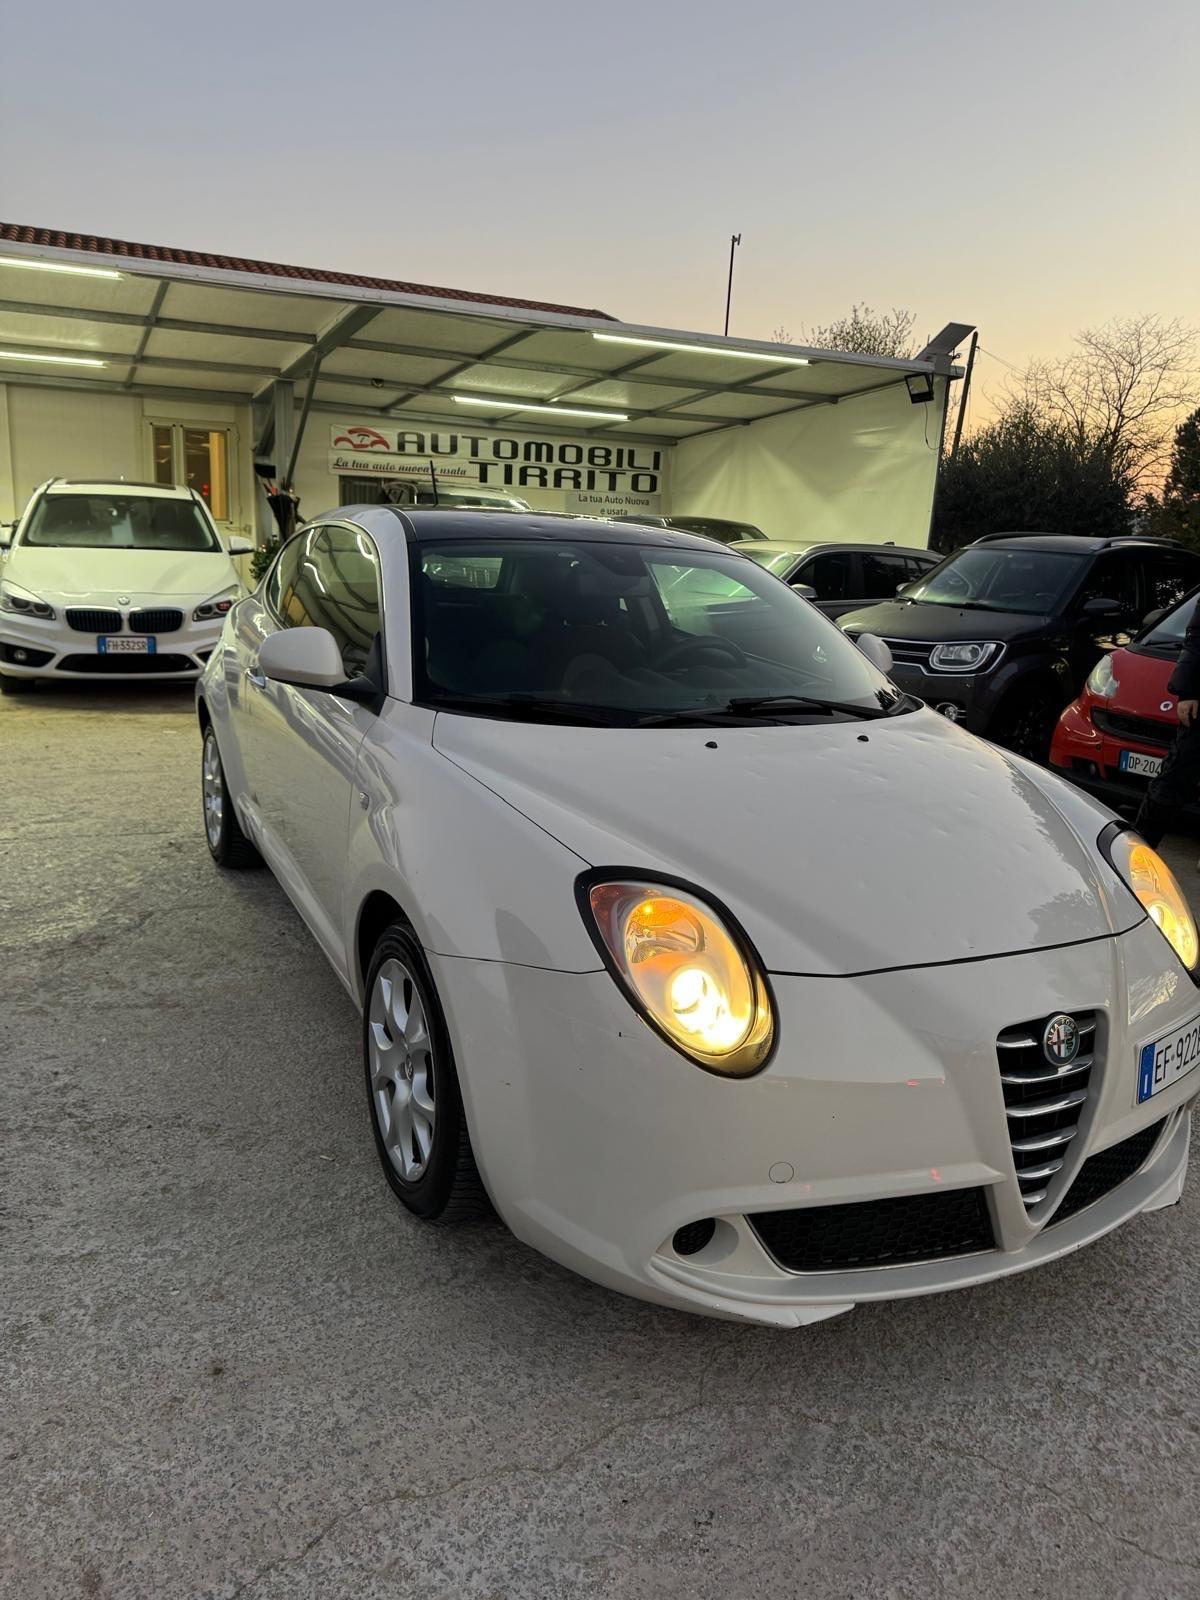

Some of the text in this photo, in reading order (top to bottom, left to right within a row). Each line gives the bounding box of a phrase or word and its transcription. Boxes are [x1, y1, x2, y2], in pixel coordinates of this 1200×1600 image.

[397, 431, 661, 471] AUTOMOBILI
[333, 456, 349, 468] La
[351, 459, 369, 469] tua
[372, 461, 396, 471] auto
[398, 463, 430, 473] nuova
[439, 466, 467, 476] usata
[469, 461, 658, 494] TIRRITO
[578, 493, 650, 506] La tua Auto Nuova
[607, 507, 628, 516] usata
